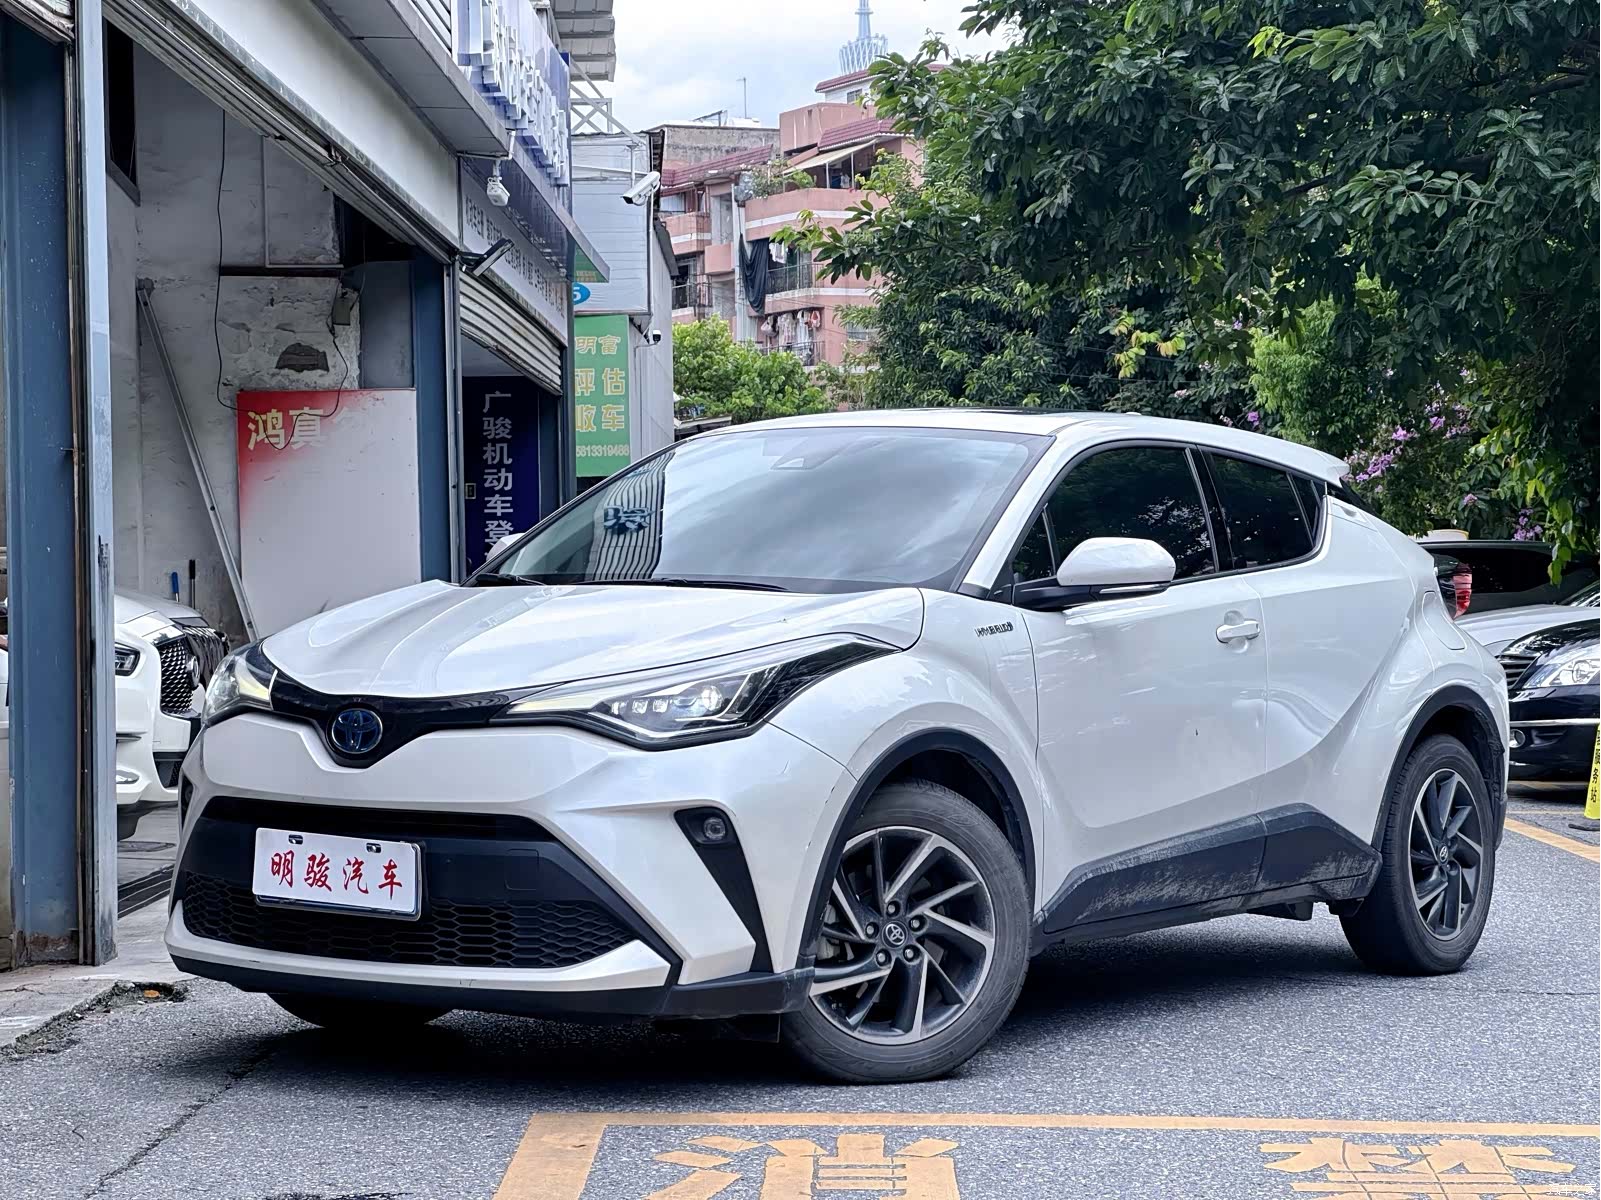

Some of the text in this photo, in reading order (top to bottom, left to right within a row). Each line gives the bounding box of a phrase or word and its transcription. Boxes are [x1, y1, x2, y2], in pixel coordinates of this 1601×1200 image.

[575, 404, 624, 432] 收车
[482, 390, 514, 557] 广骏机动车登
[270, 849, 403, 901] 明骏汽车
